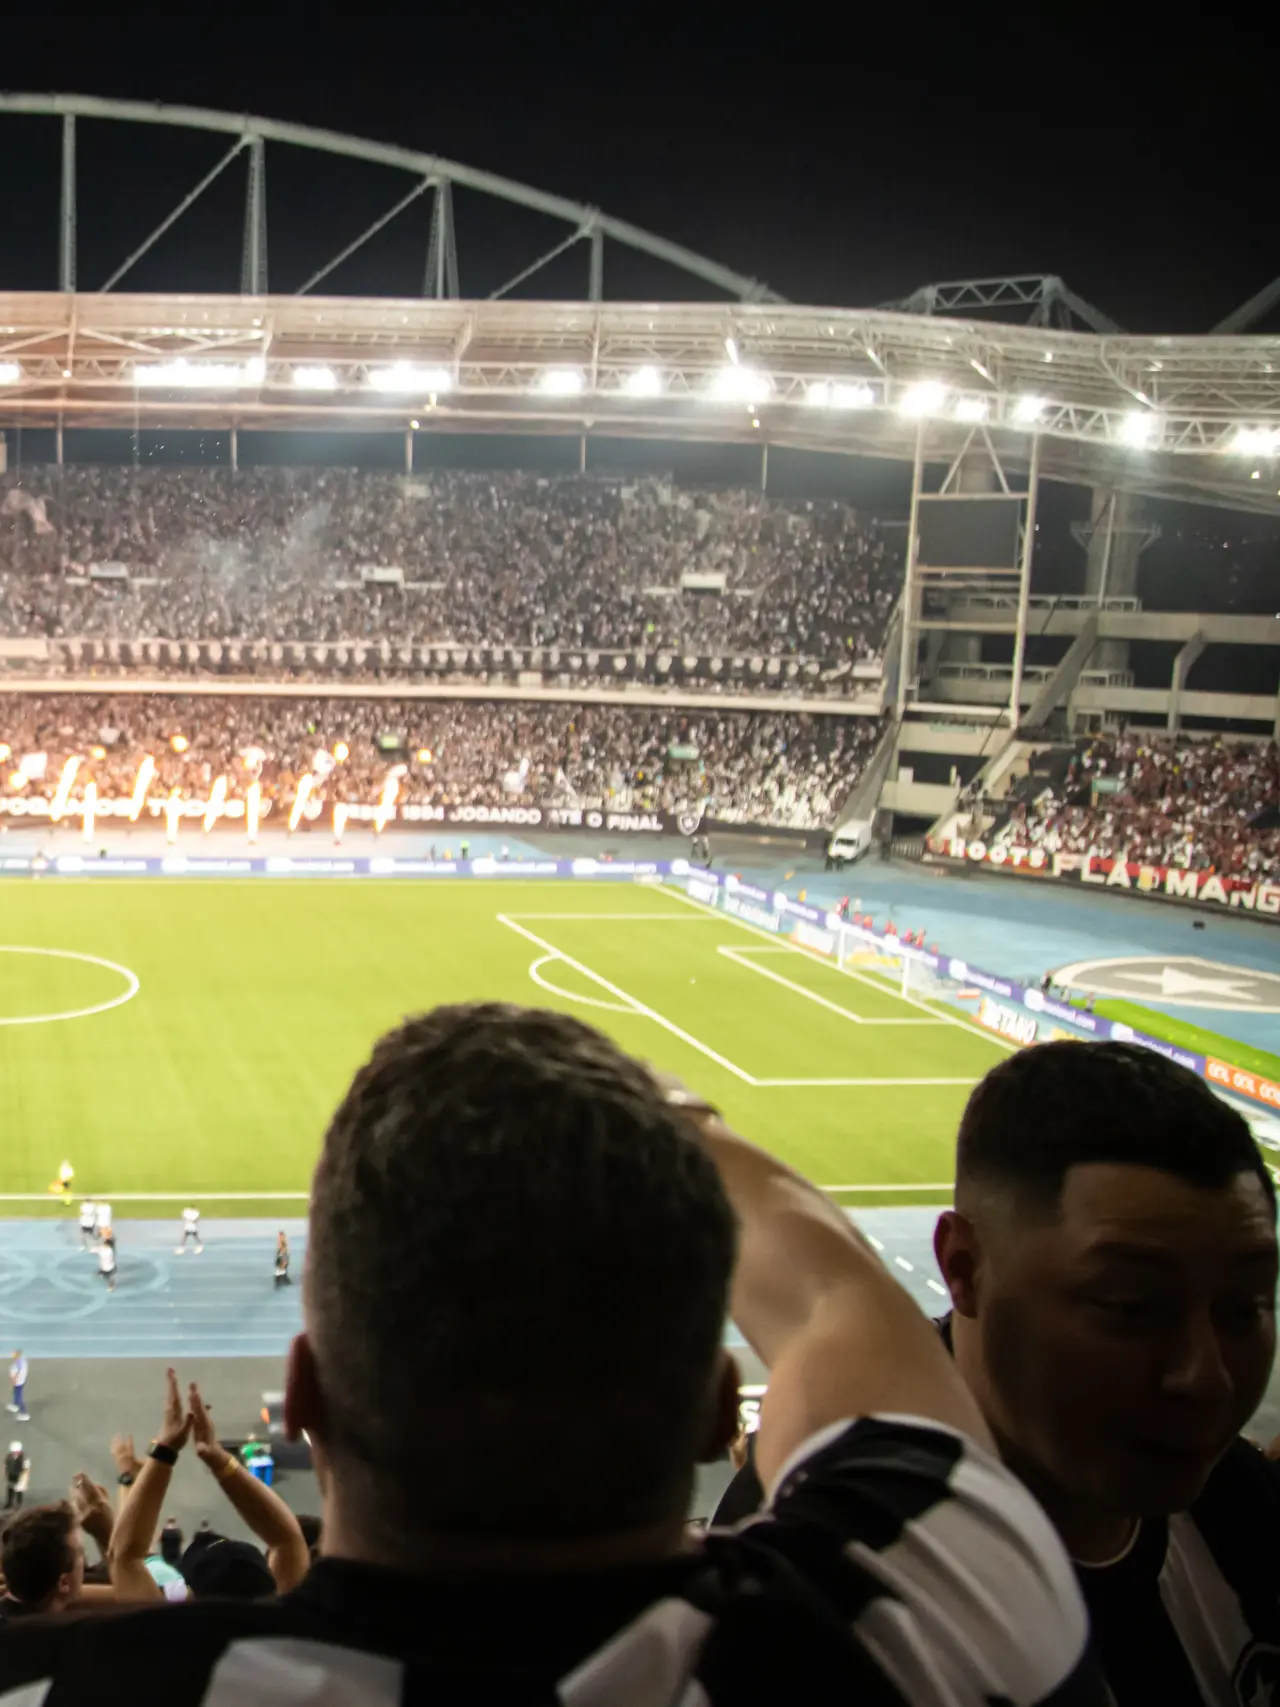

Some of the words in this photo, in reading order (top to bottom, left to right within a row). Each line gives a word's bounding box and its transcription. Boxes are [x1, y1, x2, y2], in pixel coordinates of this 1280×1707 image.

[449, 805, 542, 824] JOGANDO
[586, 811, 604, 829] O
[606, 813, 664, 831] FINAL
